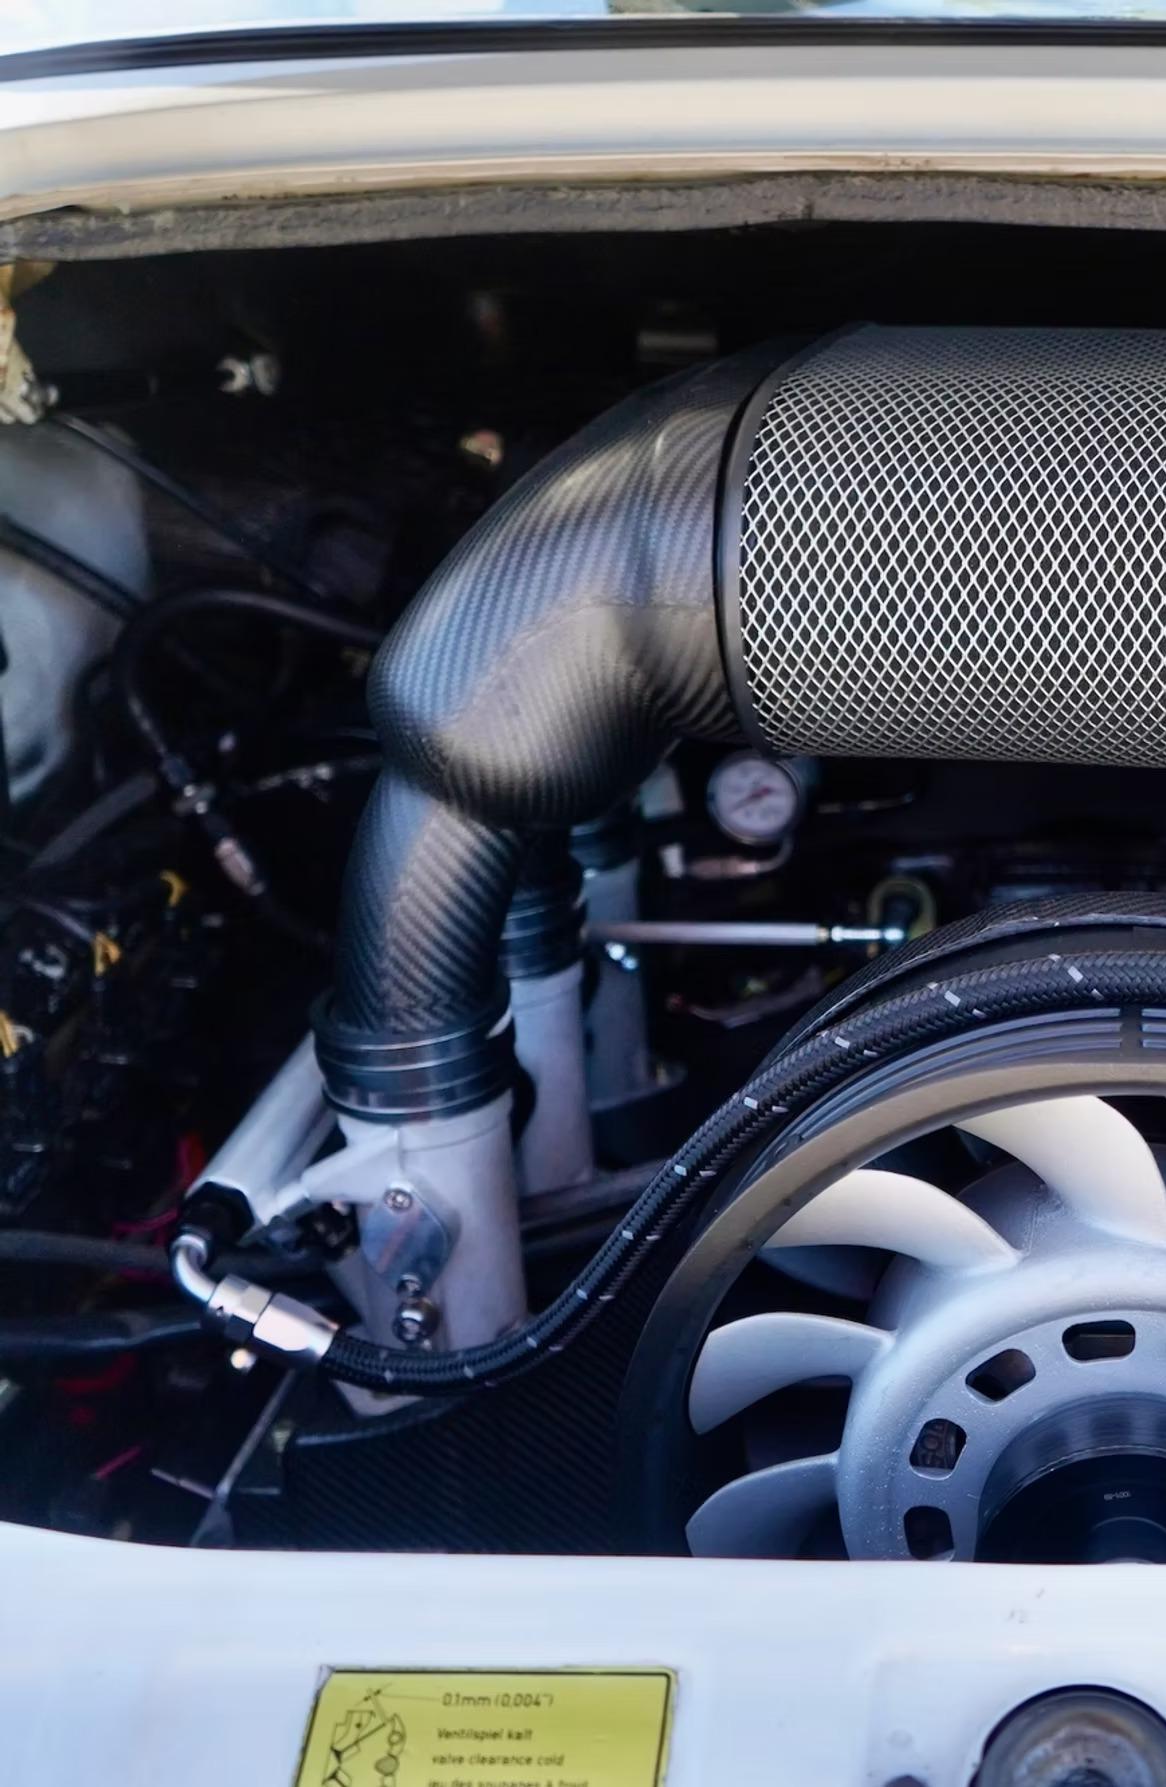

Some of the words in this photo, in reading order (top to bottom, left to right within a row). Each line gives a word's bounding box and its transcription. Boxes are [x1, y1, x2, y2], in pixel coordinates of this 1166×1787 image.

[437, 1728, 504, 1741] Ventilspiel
[507, 1729, 533, 1740] kalt
[432, 1754, 465, 1765] valve
[468, 1754, 533, 1766] clearance
[537, 1754, 565, 1766] cold
